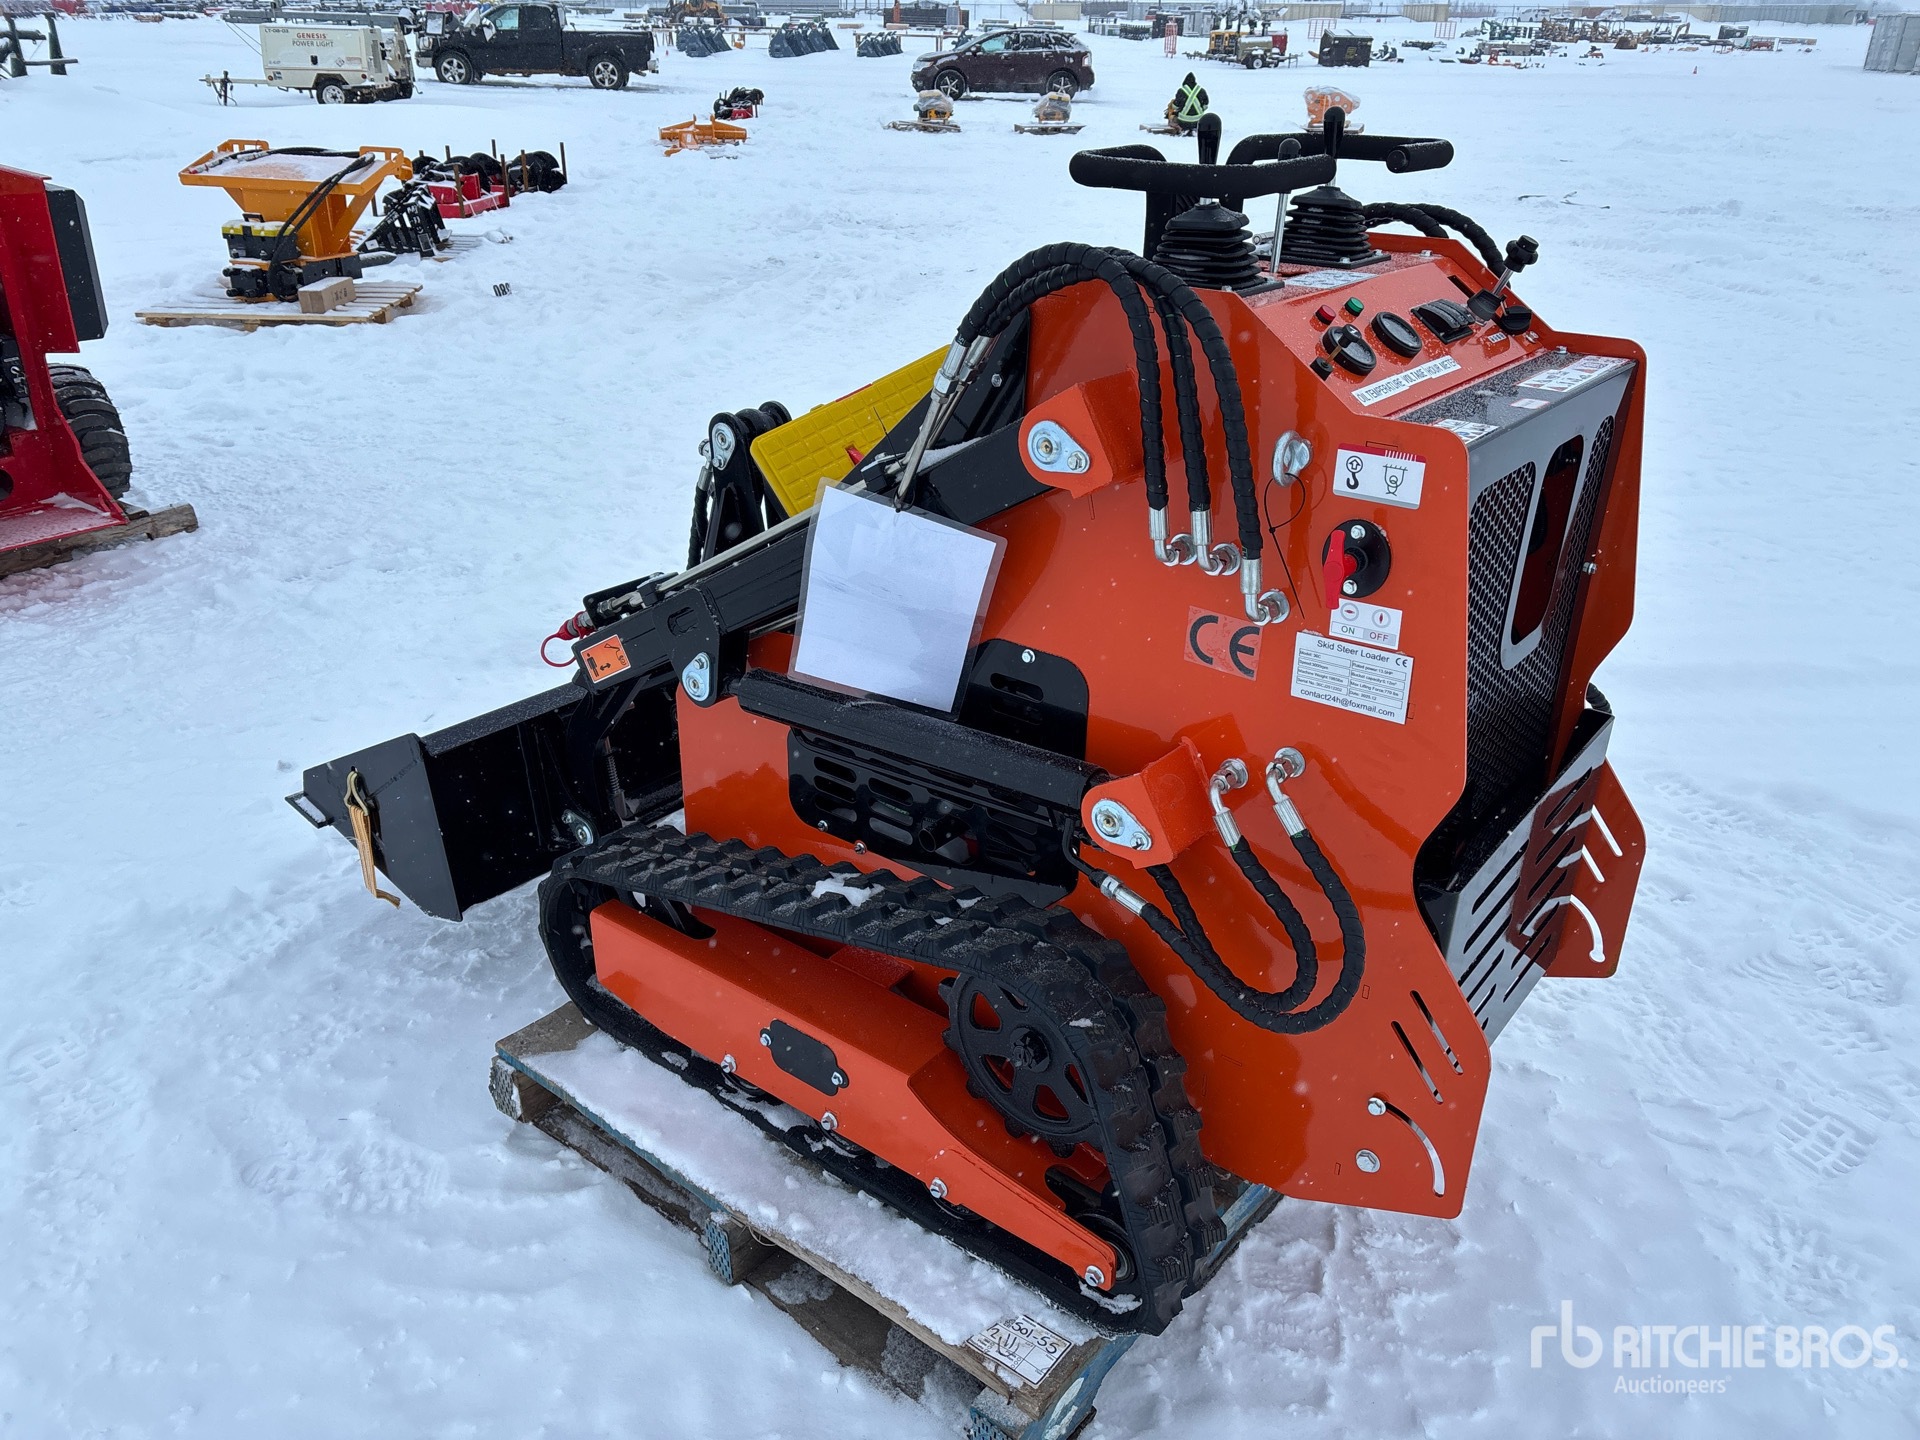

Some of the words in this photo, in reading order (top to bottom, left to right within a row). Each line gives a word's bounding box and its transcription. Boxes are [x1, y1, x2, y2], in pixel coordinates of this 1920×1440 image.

[1341, 625, 1356, 635] ON
[1369, 631, 1389, 642] OFF
[1189, 614, 1261, 679] CE
[1317, 639, 1335, 651] Skid
[1337, 644, 1359, 656] Steer
[1360, 649, 1390, 663] Loader
[1395, 657, 1408, 668] CE
[1300, 689, 1395, 718] contact24h@foxmail.com
